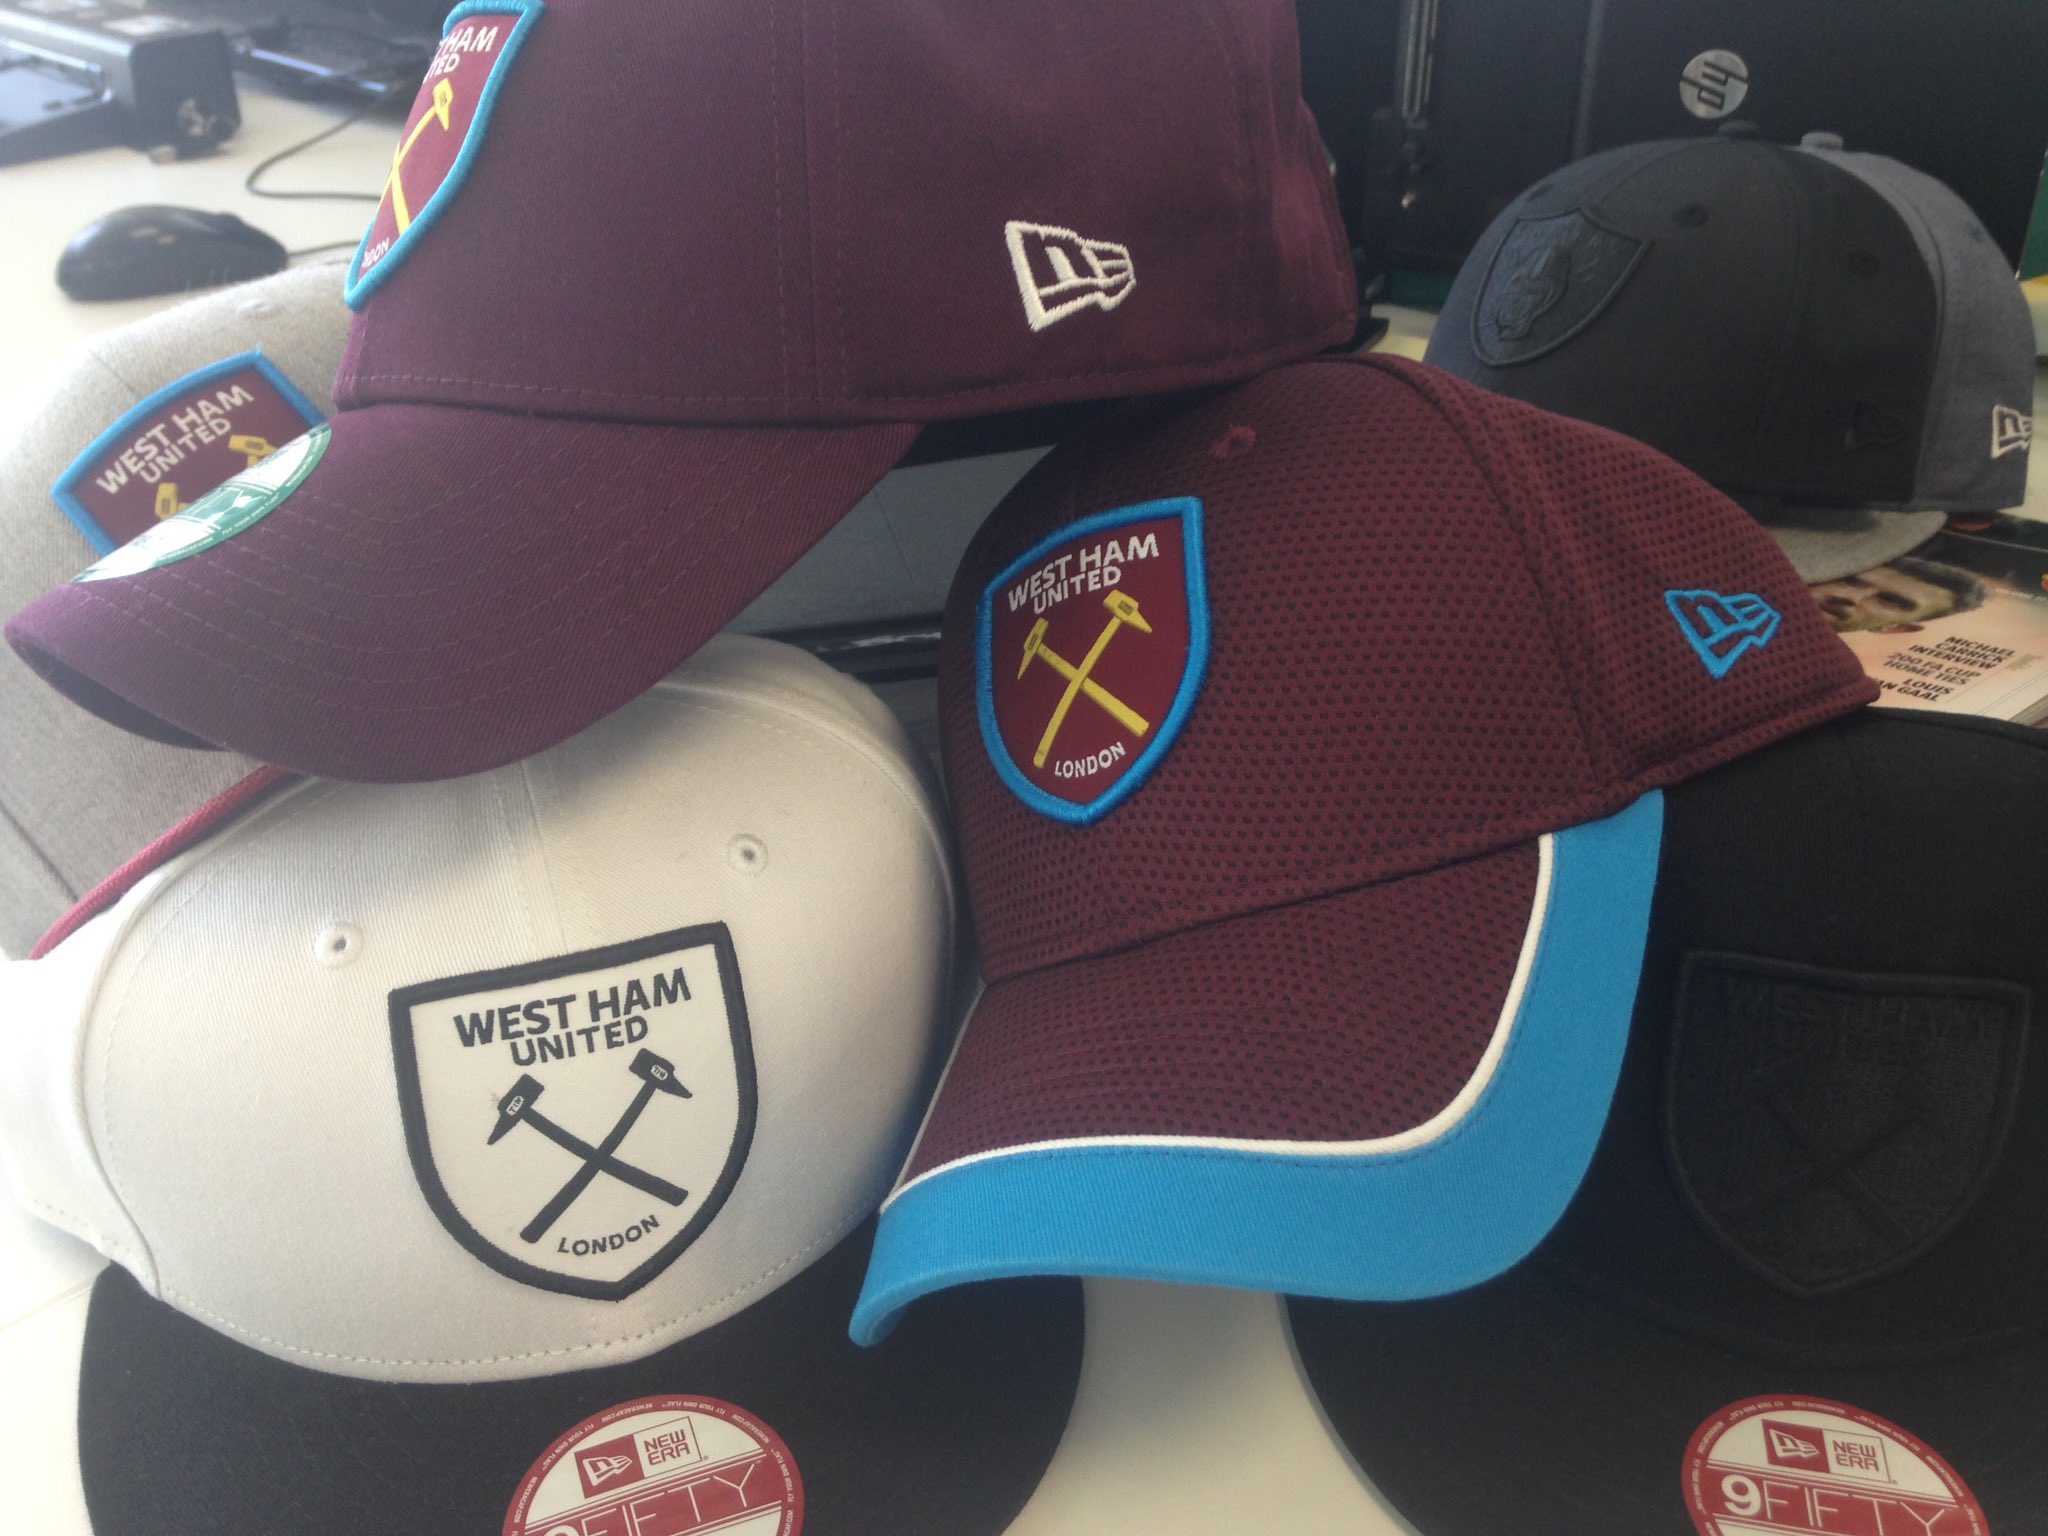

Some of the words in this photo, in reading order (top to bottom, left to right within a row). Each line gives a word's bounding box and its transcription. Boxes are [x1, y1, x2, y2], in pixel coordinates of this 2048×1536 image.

[96, 423, 173, 495] WEST
[171, 384, 255, 434] HAM
[139, 418, 232, 484] UNITED
[1008, 554, 1073, 612] WEST
[1079, 533, 1159, 574] HAM
[1033, 565, 1122, 615] UNITED
[1908, 645, 1997, 670] INTERVIEW
[1935, 642, 2006, 663] CARRICK
[1944, 636, 2016, 657] MICHAEL
[1884, 660, 1933, 677] HOME
[1934, 673, 1971, 686] TIES
[1923, 661, 1943, 671] FA
[1945, 667, 1981, 678] CUP
[1878, 680, 1898, 690] AN
[1898, 687, 1941, 701] GAAL
[1903, 678, 1955, 695] LOUIS
[1054, 742, 1127, 779] LONDON
[453, 994, 577, 1048] WEST
[587, 967, 692, 1022] HAM
[510, 1015, 649, 1067] UNITED
[557, 1214, 660, 1256] LONDON
[643, 1429, 686, 1453] NEW
[648, 1442, 690, 1466] ERA
[1832, 1439, 1877, 1458] NEW
[1836, 1453, 1880, 1472] ERA
[543, 1463, 755, 1536] FIFTY
[1721, 1474, 1945, 1536] 9FIFTY
